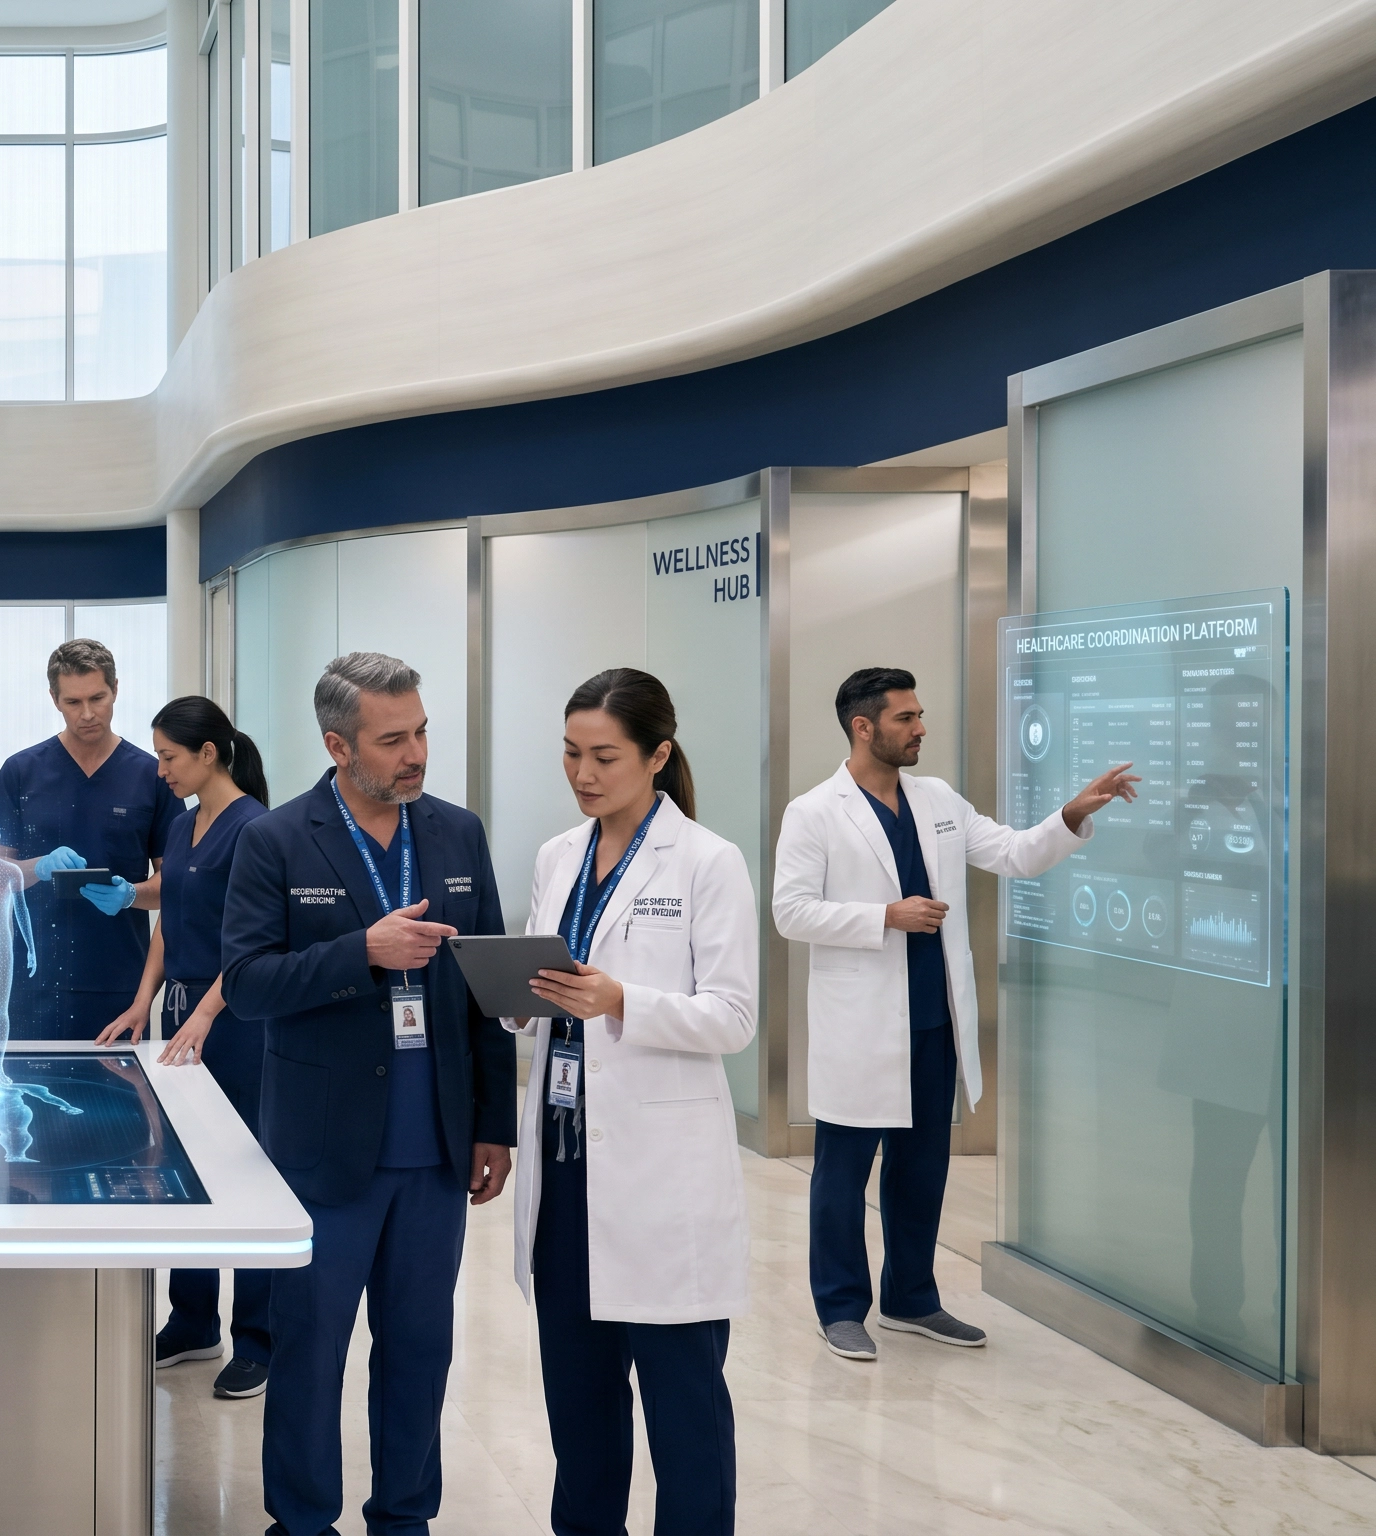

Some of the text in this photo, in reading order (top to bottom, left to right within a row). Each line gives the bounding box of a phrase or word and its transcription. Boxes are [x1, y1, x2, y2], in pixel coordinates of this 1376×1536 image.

[652, 536, 750, 576] WELLNESS
[714, 574, 750, 603] HUB
[1016, 617, 1258, 654] HEALTHCARE COORDINATION PLATFORM
